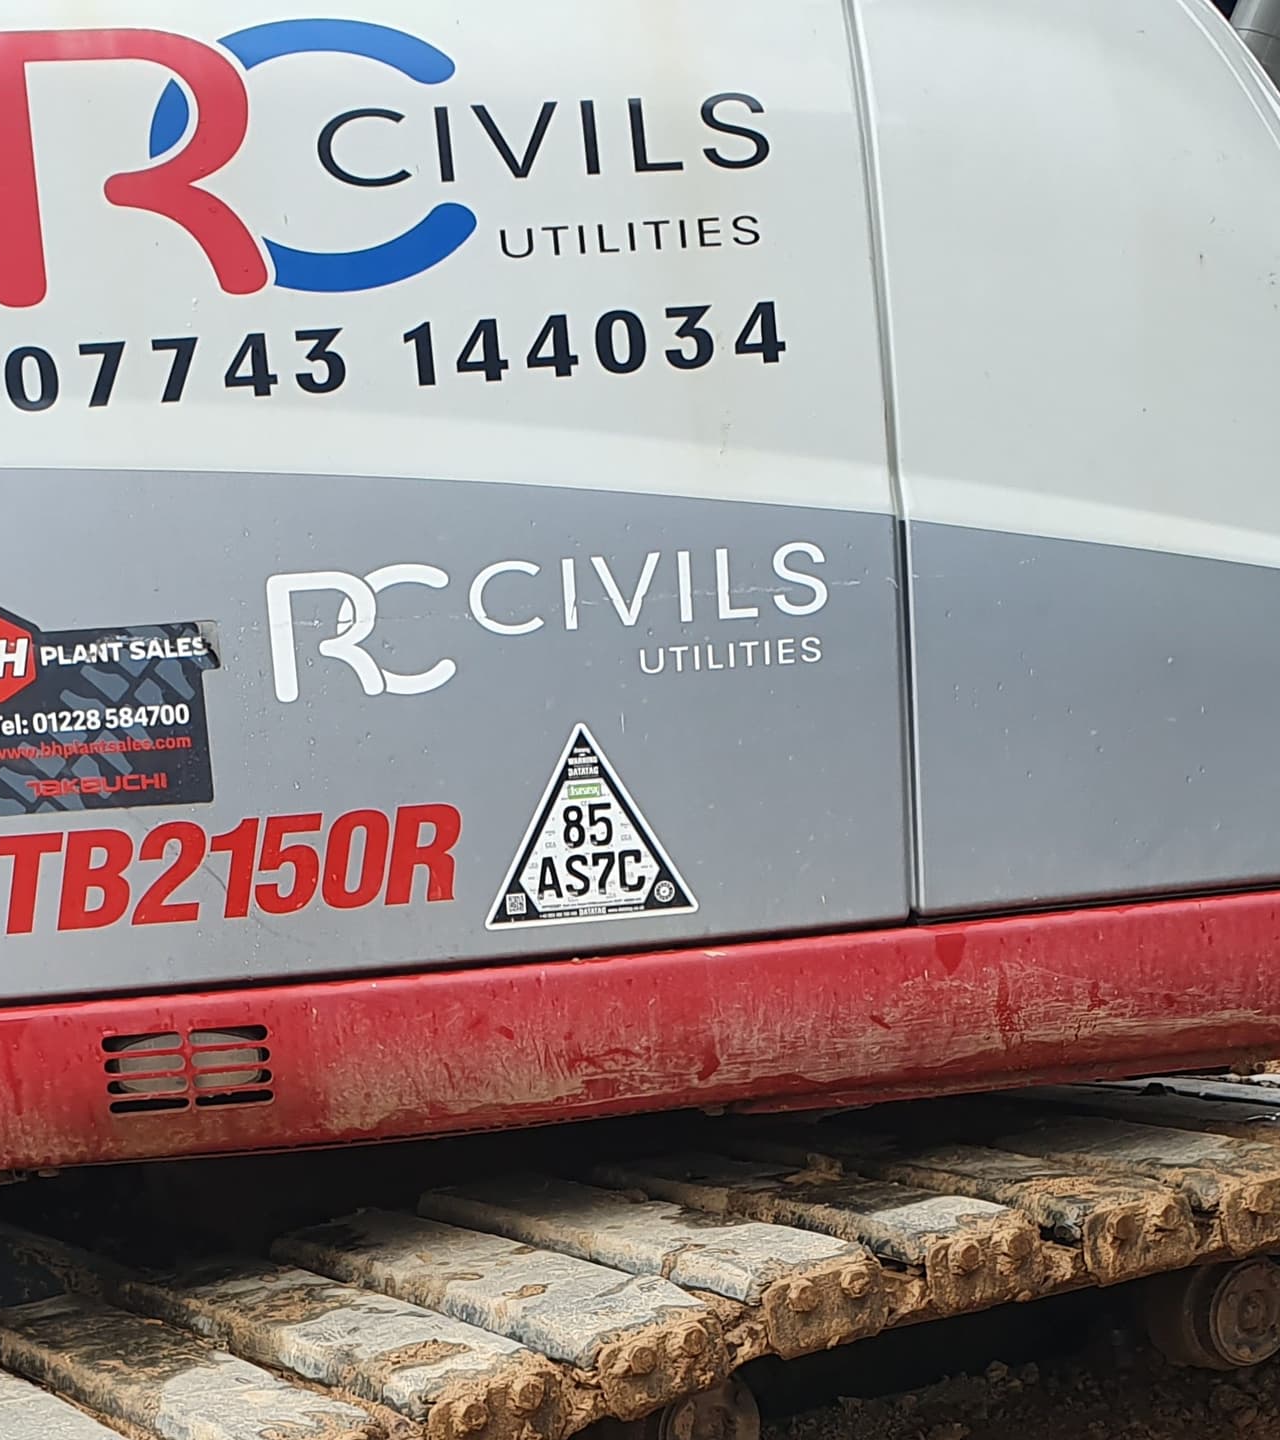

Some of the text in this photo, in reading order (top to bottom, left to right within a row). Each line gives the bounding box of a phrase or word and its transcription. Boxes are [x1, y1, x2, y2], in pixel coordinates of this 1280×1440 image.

[317, 92, 771, 187] CIVILS
[499, 215, 762, 258] UTILITIES
[3, 300, 787, 411] 07743 144034
[469, 541, 828, 636] CIVILS
[39, 636, 209, 667] PLANT SALES
[265, 563, 457, 703] RC
[638, 637, 823, 675] UTILITIES
[32, 709, 101, 735] 01228
[105, 704, 190, 730] 584700
[25, 773, 168, 797] TAKEUCHI
[563, 803, 613, 849] 85
[537, 849, 646, 900] AS7C
